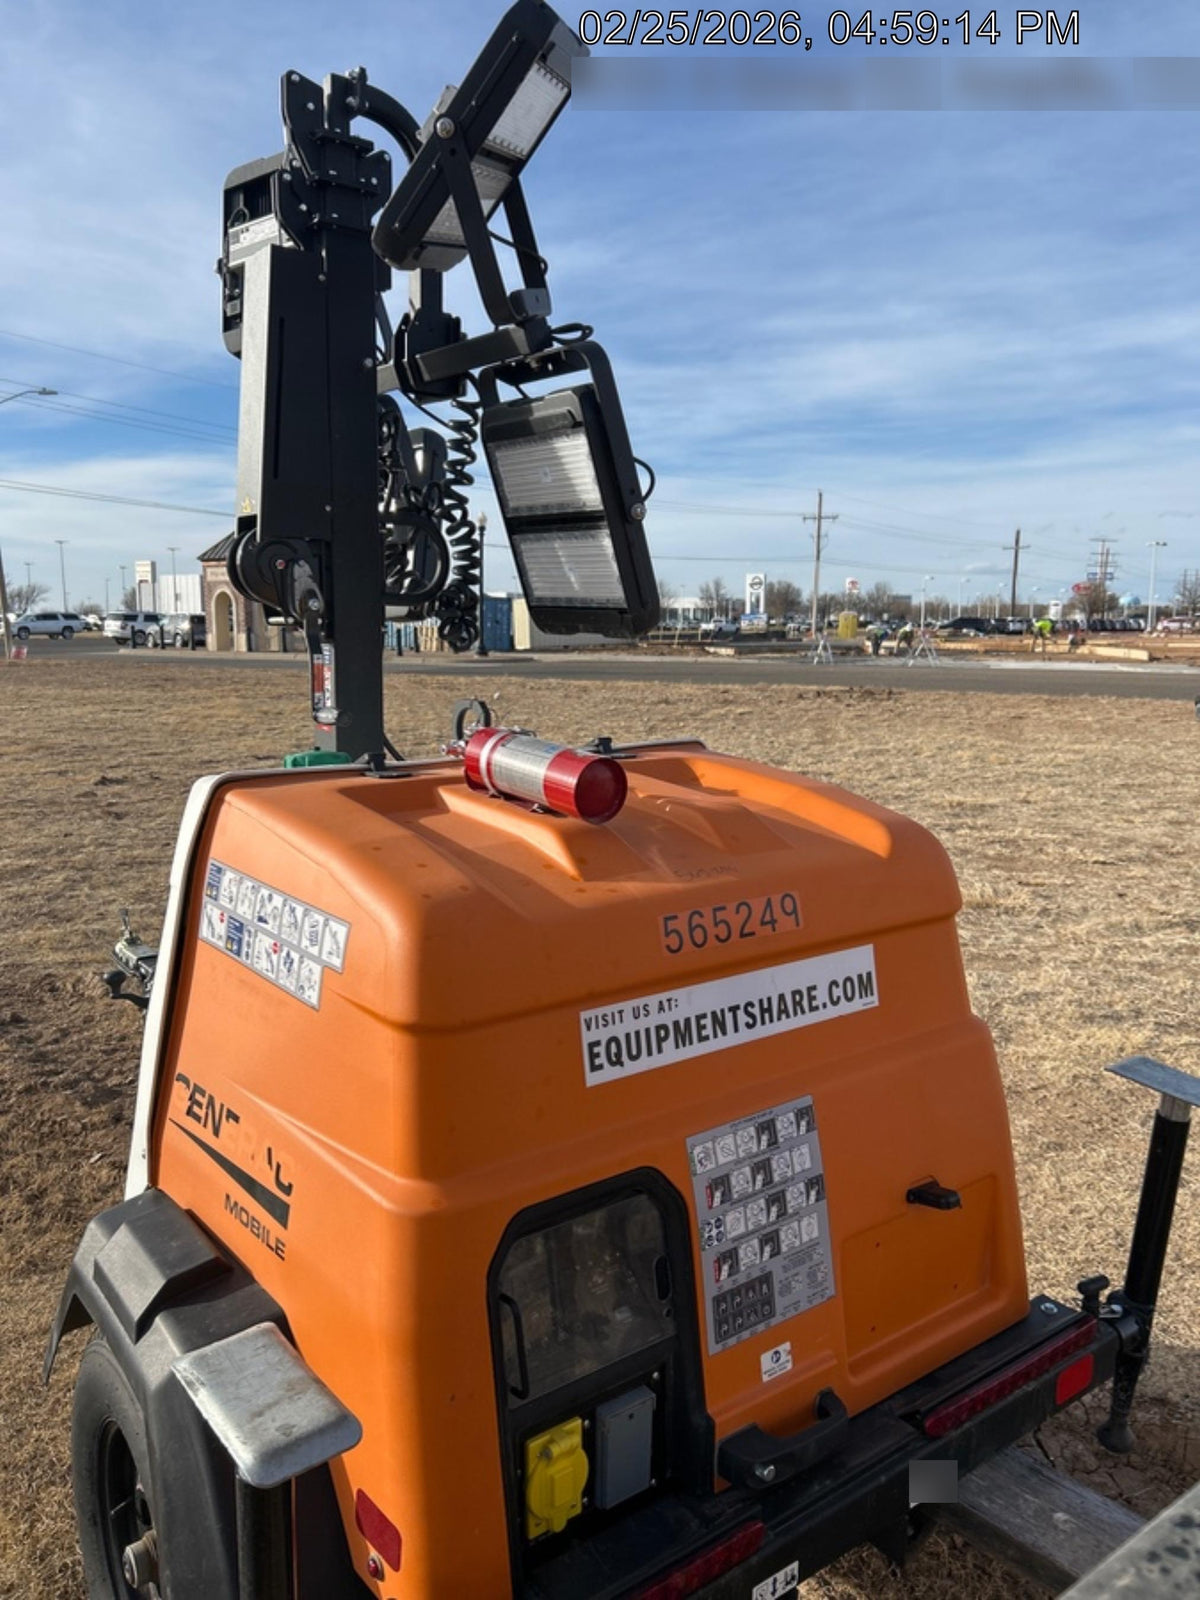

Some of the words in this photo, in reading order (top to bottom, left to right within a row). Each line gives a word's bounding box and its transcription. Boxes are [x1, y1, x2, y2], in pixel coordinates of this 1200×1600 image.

[662, 892, 801, 955] 565249
[584, 1009, 625, 1032] VISIT
[632, 1000, 650, 1020] US
[657, 997, 679, 1013] AT:
[587, 970, 875, 1073] EQUIPMENTSHARE.COM
[224, 1192, 286, 1262] MOBILE
